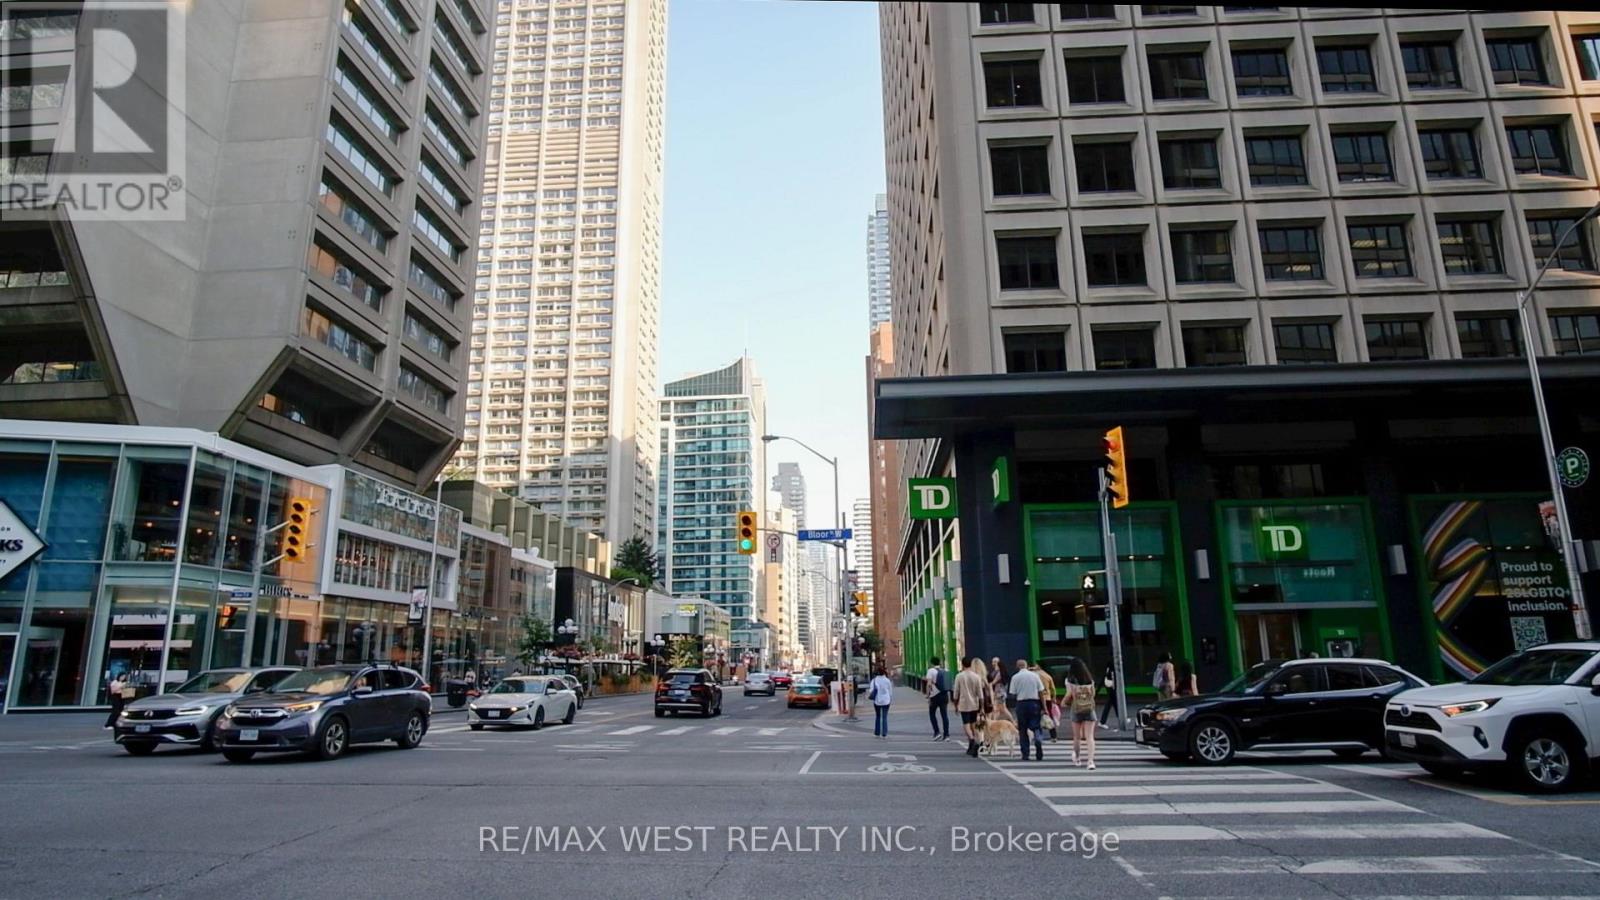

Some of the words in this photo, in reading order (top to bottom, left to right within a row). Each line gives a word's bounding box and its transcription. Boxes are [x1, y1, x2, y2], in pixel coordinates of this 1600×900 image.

[1566, 457, 1579, 473] P
[913, 485, 951, 510] TD
[808, 530, 829, 539] Bloor
[836, 530, 842, 538] W
[1262, 525, 1303, 552] TD
[1500, 562, 1538, 572] Proud
[1540, 562, 1553, 571] to
[1503, 575, 1553, 586] support
[1507, 600, 1569, 611] inclusion.
